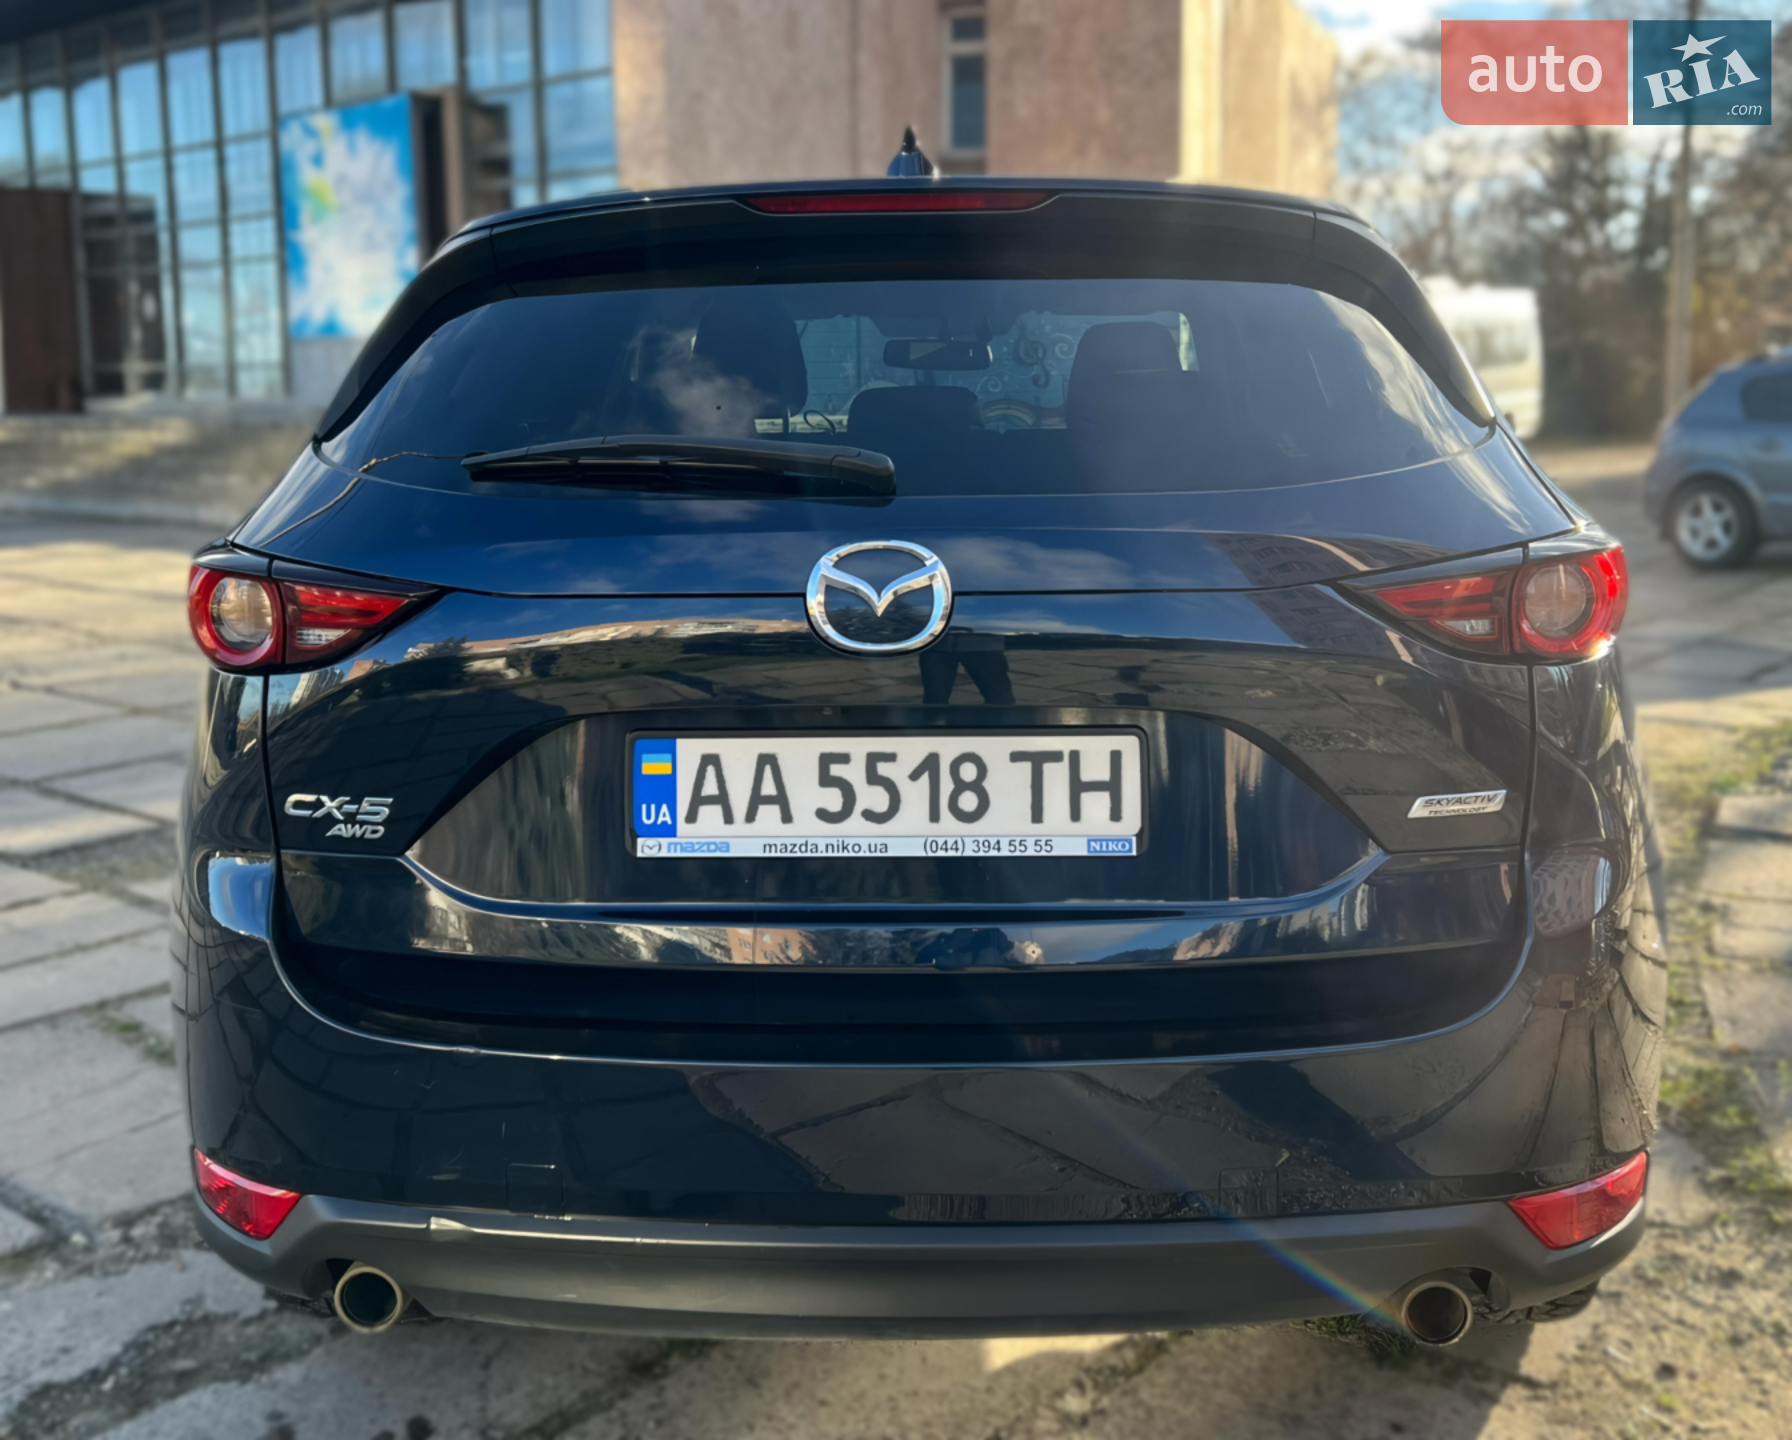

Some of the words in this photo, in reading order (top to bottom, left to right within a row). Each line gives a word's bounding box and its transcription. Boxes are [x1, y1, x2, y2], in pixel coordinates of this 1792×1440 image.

[684, 752, 794, 826] AA
[814, 751, 991, 825] 5518
[1009, 749, 1123, 825] TH
[284, 793, 394, 823] CX-5
[1422, 794, 1498, 808] SKYACTIV
[641, 803, 673, 825] UA
[325, 823, 385, 839] AWD
[762, 839, 889, 855] mazda.niko.ua
[923, 837, 966, 855] (044)
[971, 839, 1002, 854] 394
[1008, 839, 1028, 854] 55
[1033, 839, 1054, 854] 55
[1089, 841, 1131, 853] NIKO
